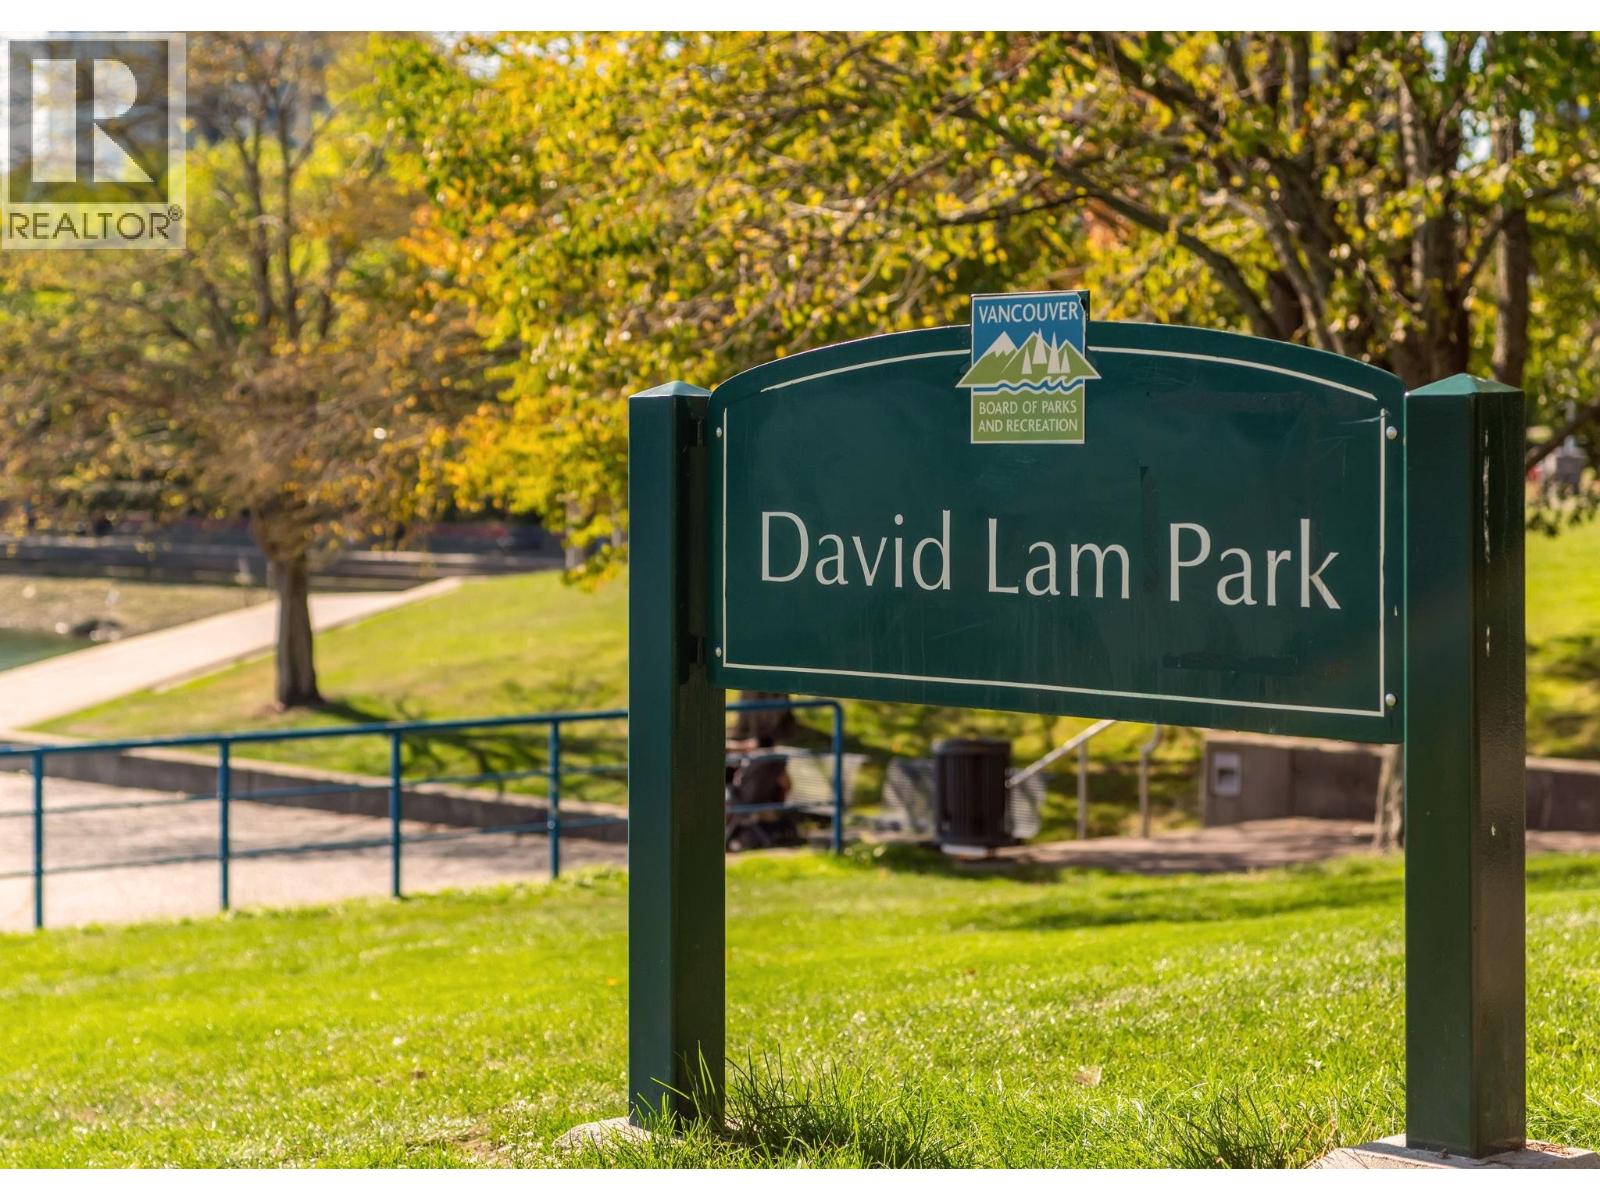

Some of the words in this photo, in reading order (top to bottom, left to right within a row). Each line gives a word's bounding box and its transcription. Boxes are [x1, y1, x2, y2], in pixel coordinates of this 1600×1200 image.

[978, 301, 1079, 324] VANCOUVER
[978, 401, 1018, 415] BOARD
[1022, 400, 1038, 414] OF
[1042, 399, 1077, 414] PARKS
[978, 419, 1004, 433] AND
[1006, 418, 1078, 432] RECREATION
[761, 509, 951, 591] David
[988, 518, 1130, 600] Lam
[1169, 518, 1342, 610] Park
